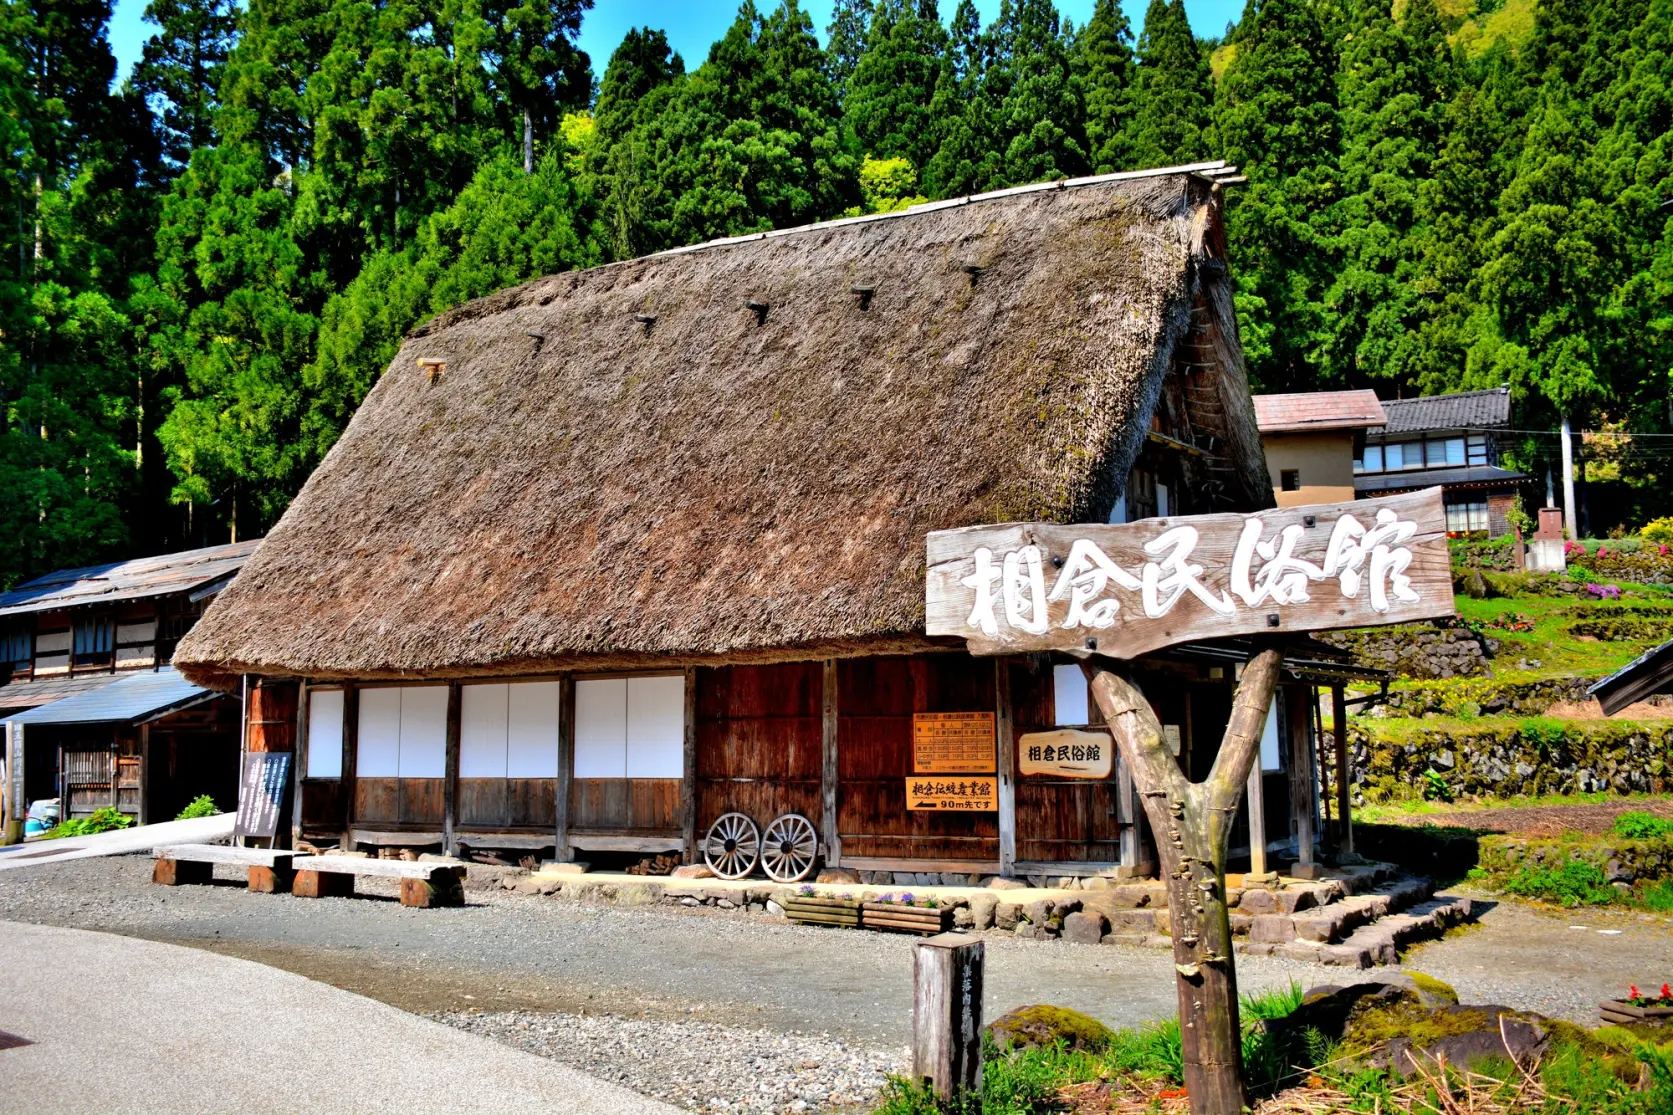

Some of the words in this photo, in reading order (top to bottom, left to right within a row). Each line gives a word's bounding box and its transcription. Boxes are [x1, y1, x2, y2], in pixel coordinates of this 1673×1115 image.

[960, 507, 1421, 638] 相倉民俗館
[1028, 744, 1101, 762] 相倉民俗館
[911, 781, 992, 796] 相倉伝統産業館
[940, 800, 992, 809] 90m先です
